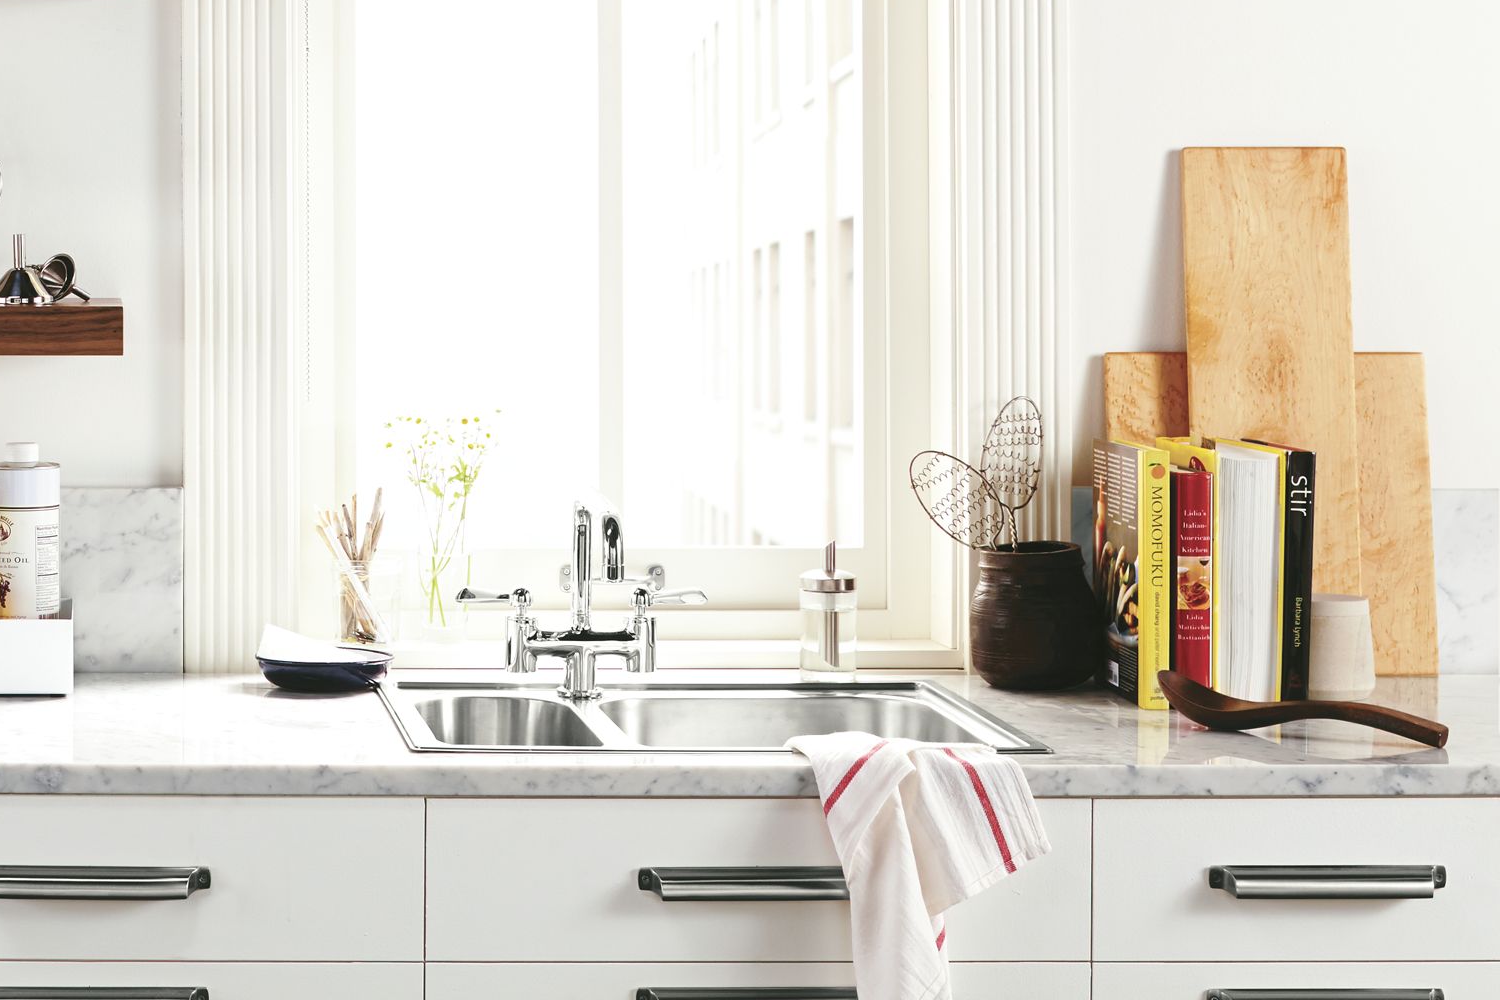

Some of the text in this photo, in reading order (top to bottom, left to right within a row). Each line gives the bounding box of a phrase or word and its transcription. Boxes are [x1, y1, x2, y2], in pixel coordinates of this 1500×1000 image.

[1291, 475, 1312, 516] stir
[1151, 486, 1164, 587] MOMOFUKU
[14, 556, 28, 564] OIL
[1292, 597, 1303, 647] Barbara Lynch
